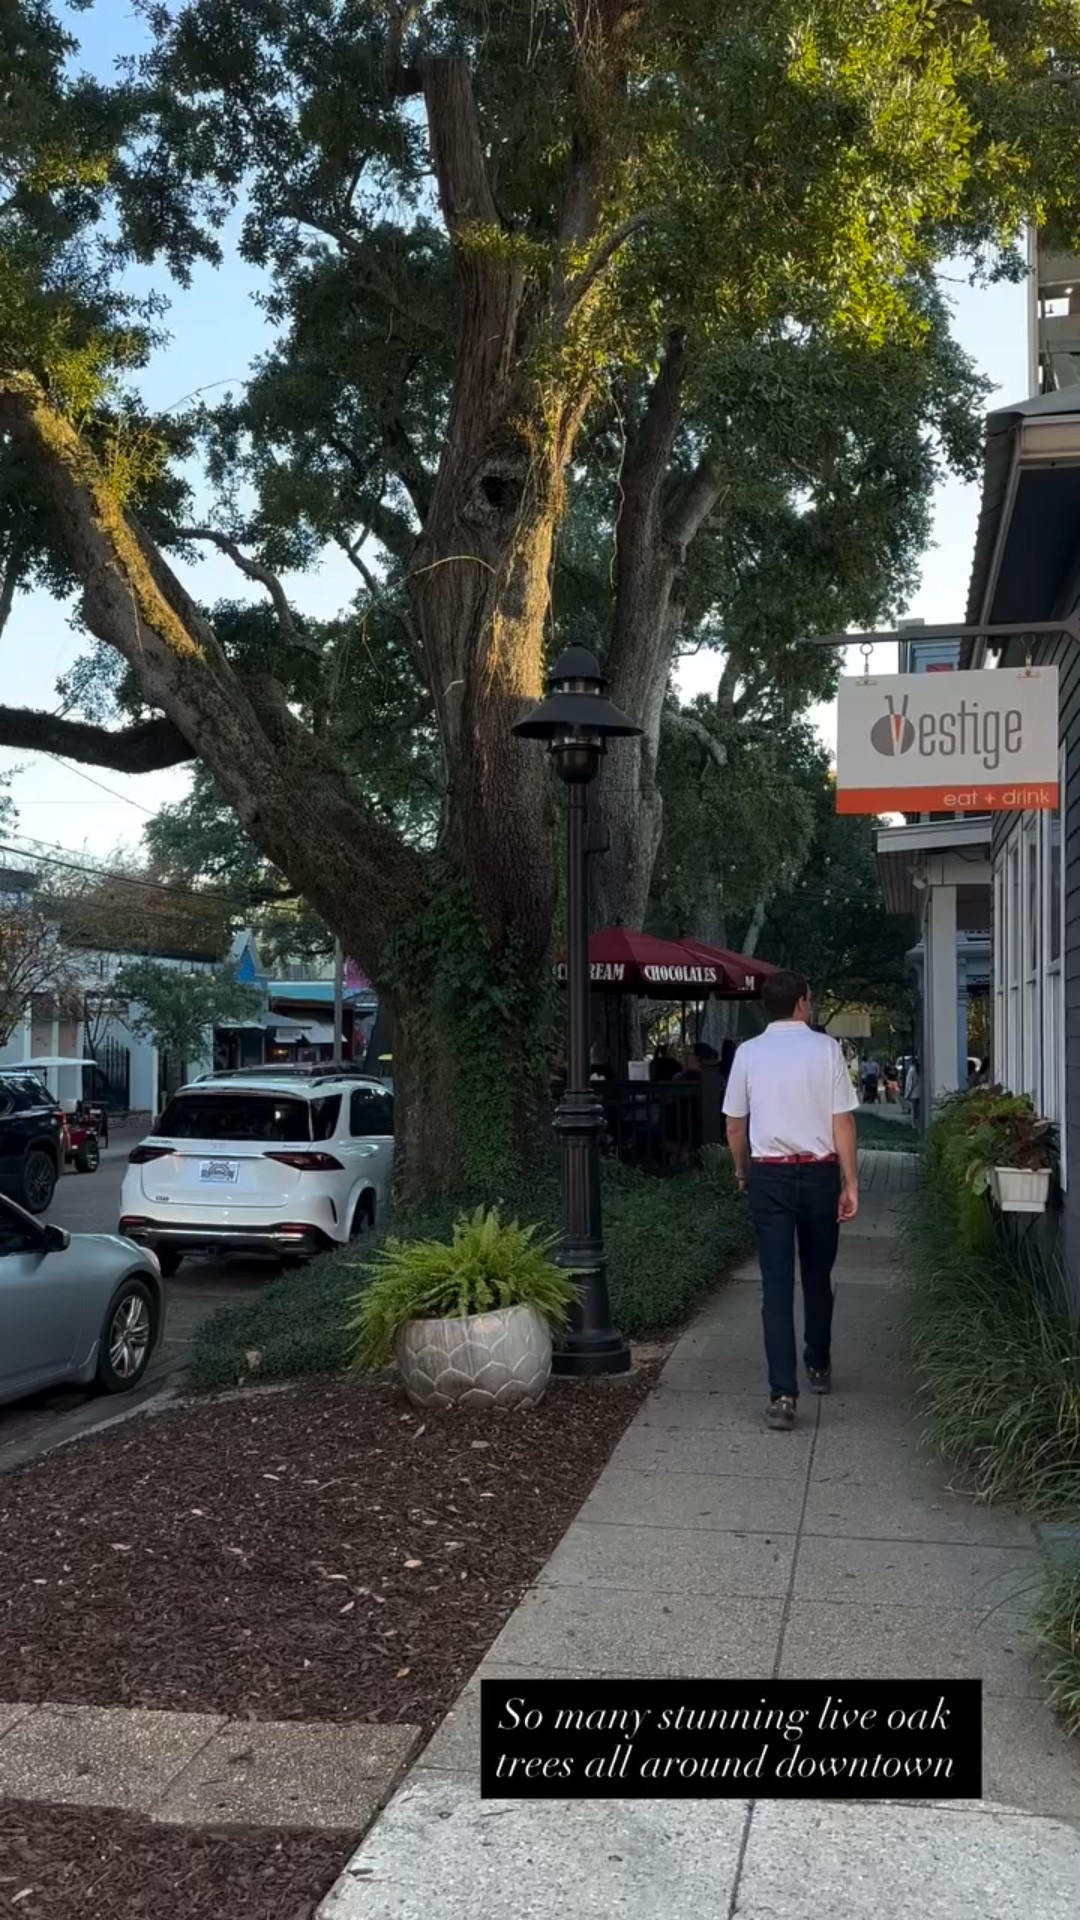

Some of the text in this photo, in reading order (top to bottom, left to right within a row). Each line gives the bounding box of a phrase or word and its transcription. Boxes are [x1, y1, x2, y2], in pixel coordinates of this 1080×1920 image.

[870, 693, 1022, 770] Vestige
[943, 789, 978, 806] eat
[1002, 787, 1050, 805] drink
[588, 962, 626, 981] REAM
[644, 964, 718, 983] CHOCOLATES
